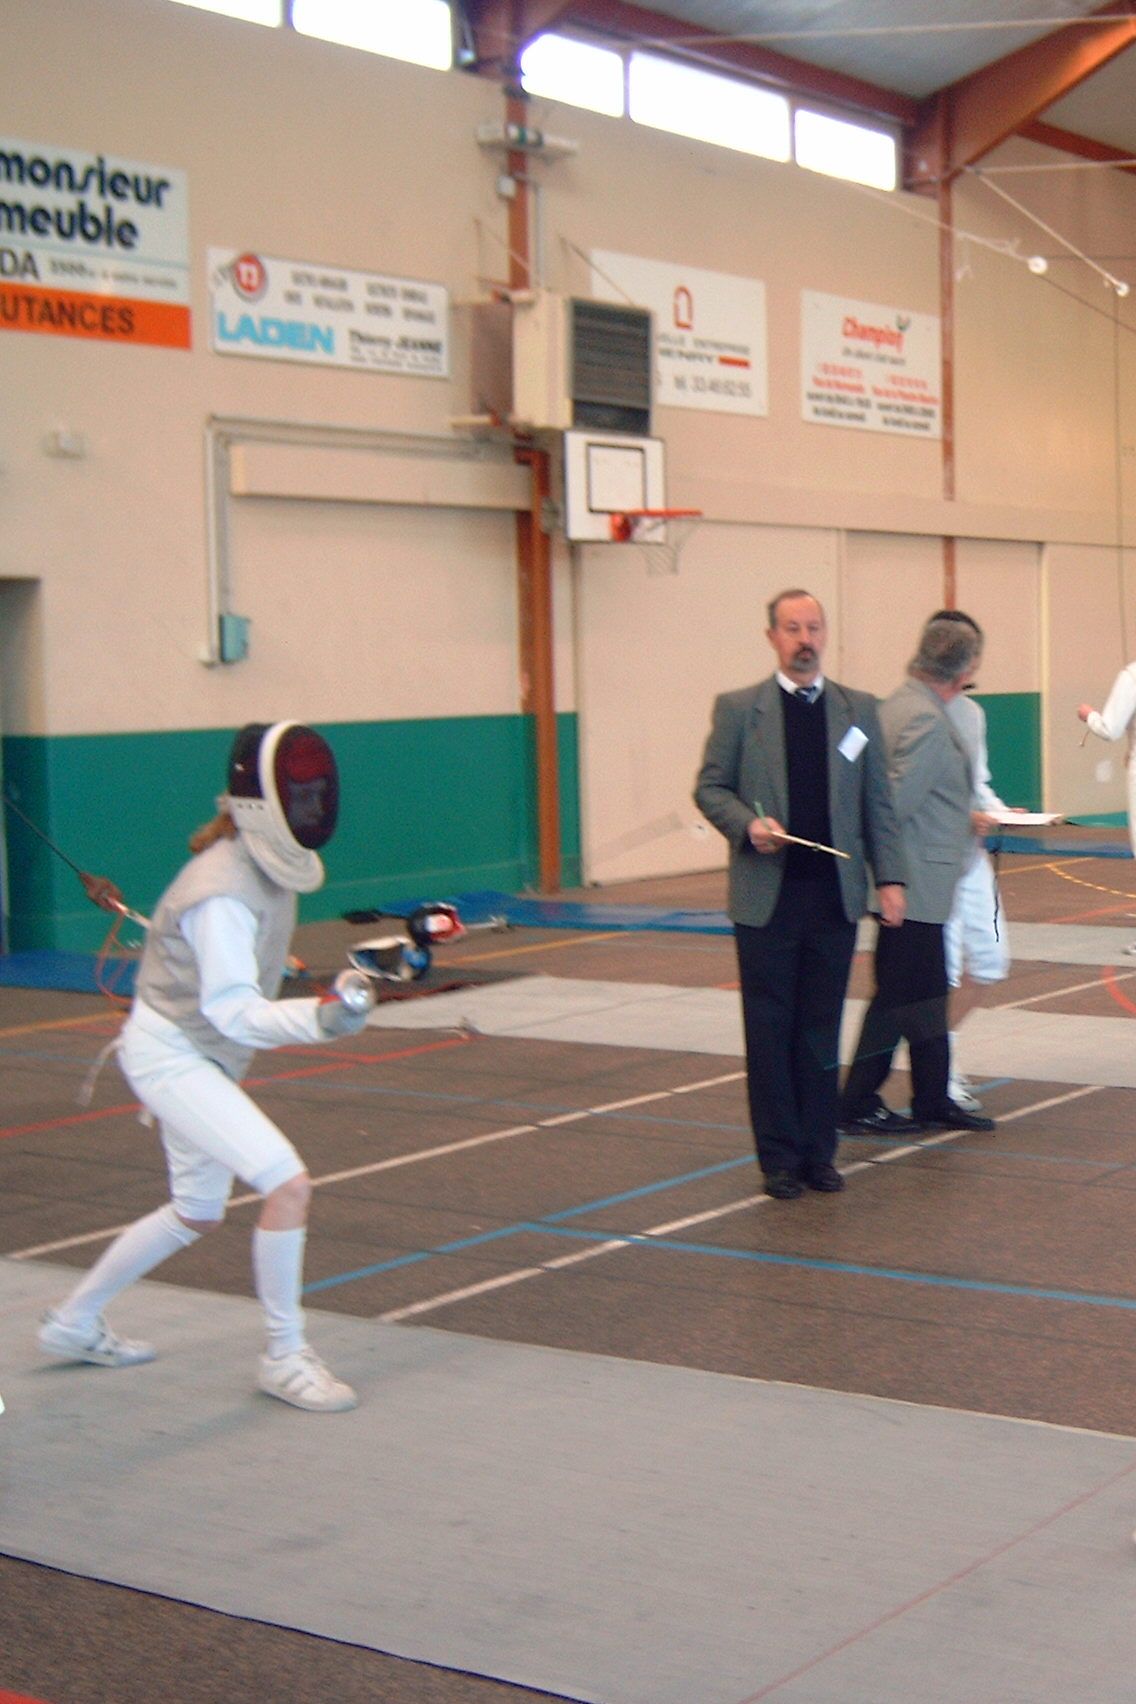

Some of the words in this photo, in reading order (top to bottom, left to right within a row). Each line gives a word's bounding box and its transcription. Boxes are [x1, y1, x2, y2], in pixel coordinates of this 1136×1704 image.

[0, 152, 170, 208] monsieur
[0, 199, 139, 249] meuble
[217, 311, 335, 355] LADEN
